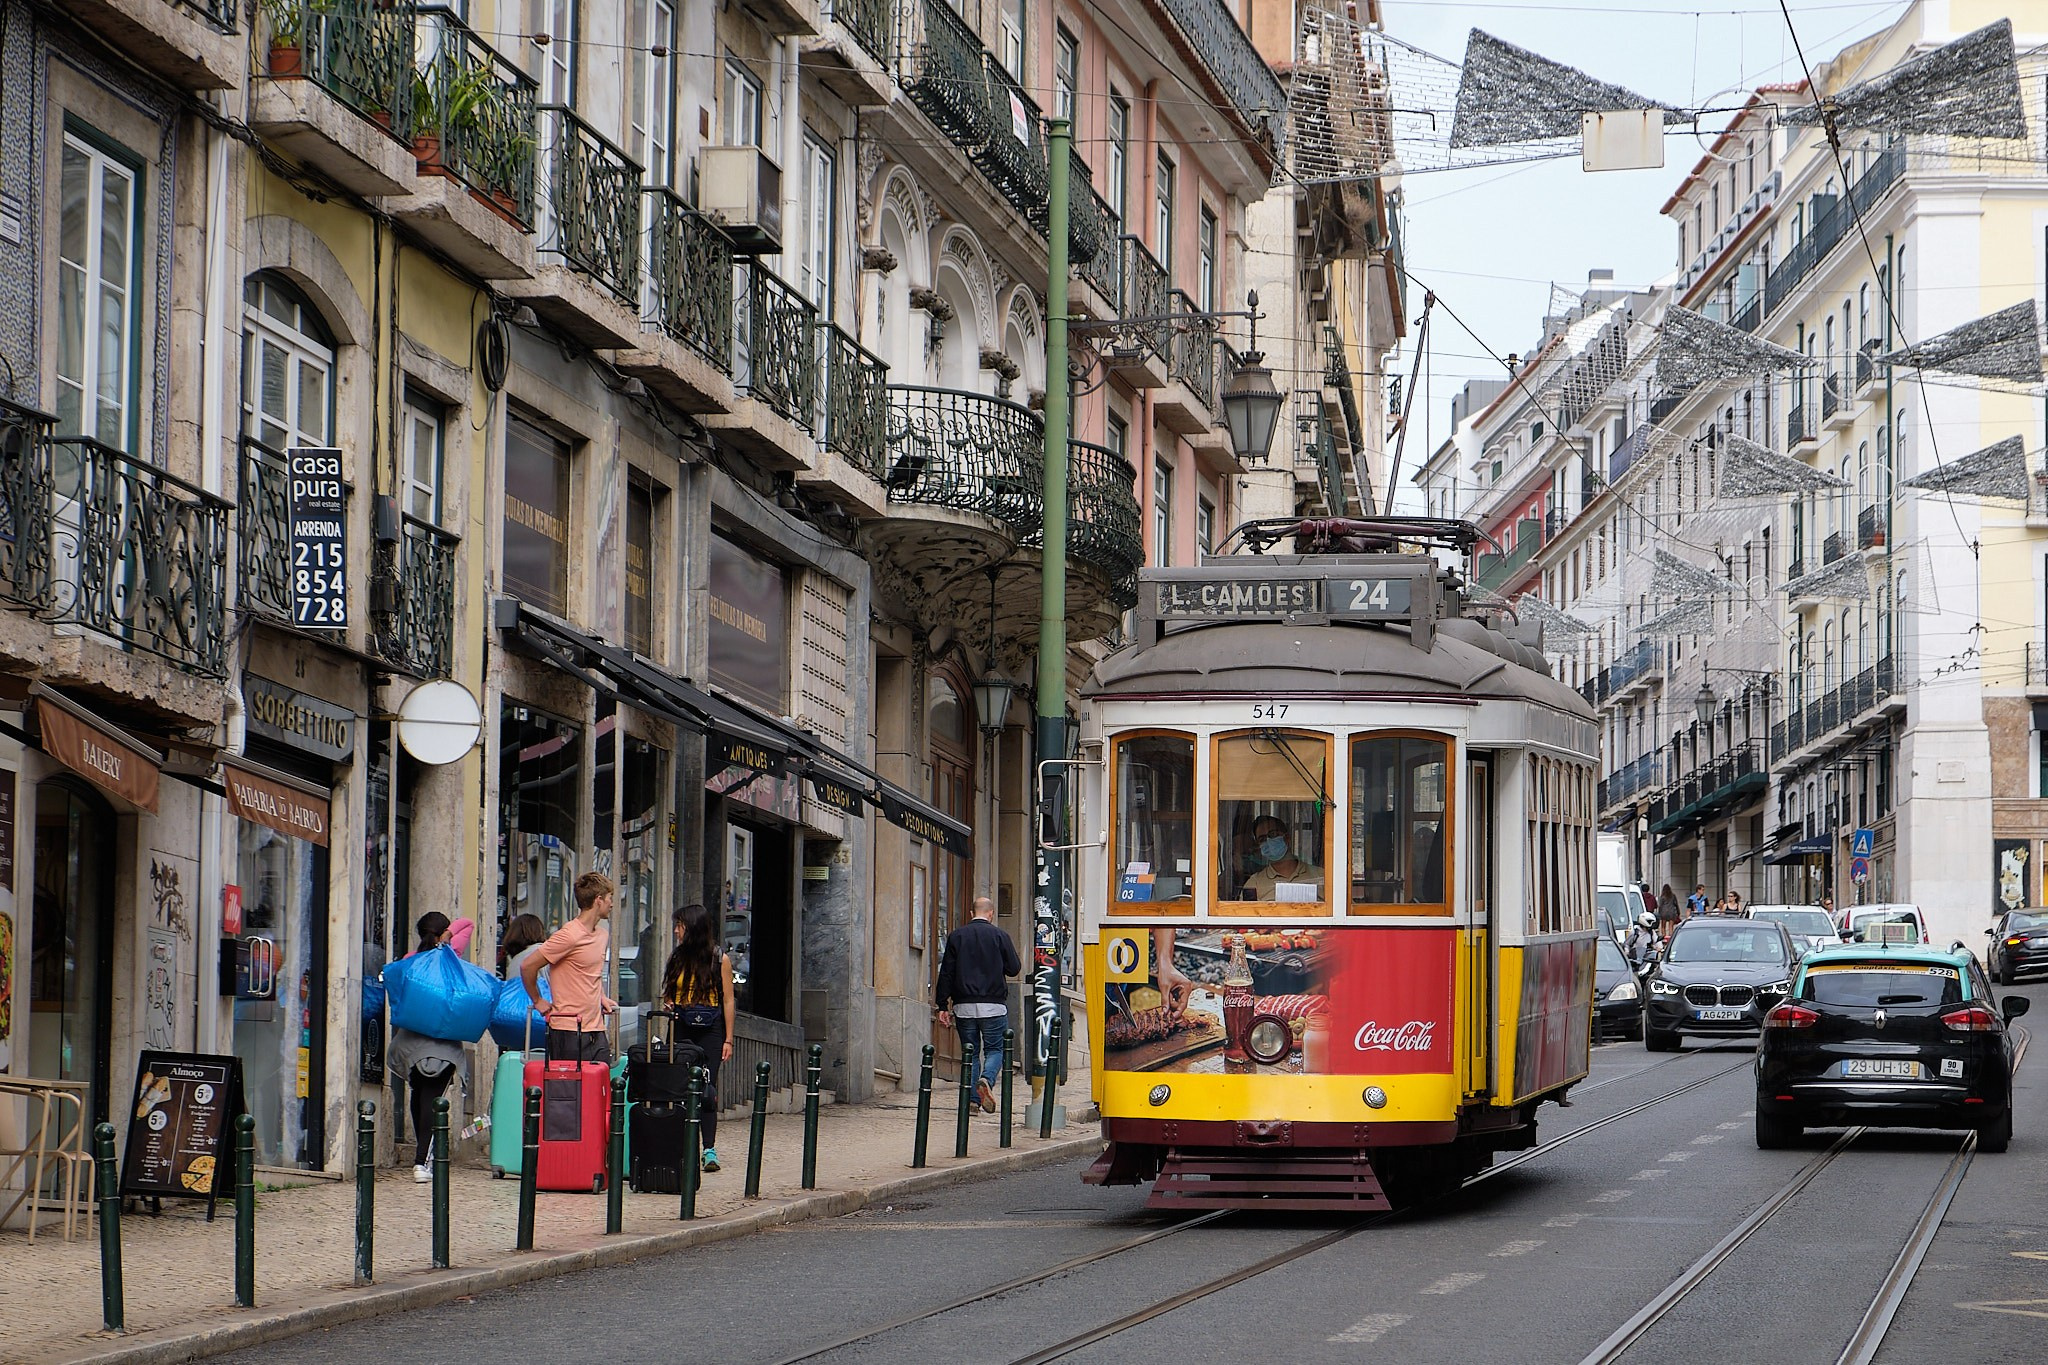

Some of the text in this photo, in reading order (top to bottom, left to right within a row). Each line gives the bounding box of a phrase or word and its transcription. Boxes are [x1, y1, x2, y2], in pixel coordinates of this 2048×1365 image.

[292, 456, 340, 475] casa
[293, 479, 341, 503] pura
[308, 500, 321, 508] real
[294, 520, 342, 538] ARRENDA
[294, 542, 343, 568] 215
[295, 569, 345, 595] 854
[1201, 582, 1304, 606] CAMÕES
[1349, 580, 1389, 611] 24
[296, 597, 345, 623] 728
[252, 690, 348, 749] SORBETTINO
[1252, 704, 1289, 719] 547
[730, 744, 767, 770] ANTIQUES
[233, 782, 278, 817] PADARIA
[288, 802, 322, 833] BAIRRO
[826, 783, 850, 808] DESIGN
[904, 810, 945, 845] DECORATIONS
[833, 849, 849, 864] 33
[1121, 889, 1134, 900] 03
[1929, 967, 1954, 978] 528
[1354, 1020, 1436, 1051] Coca-Cola
[170, 1067, 204, 1078] Almoço
[1947, 1060, 1957, 1069] 90
